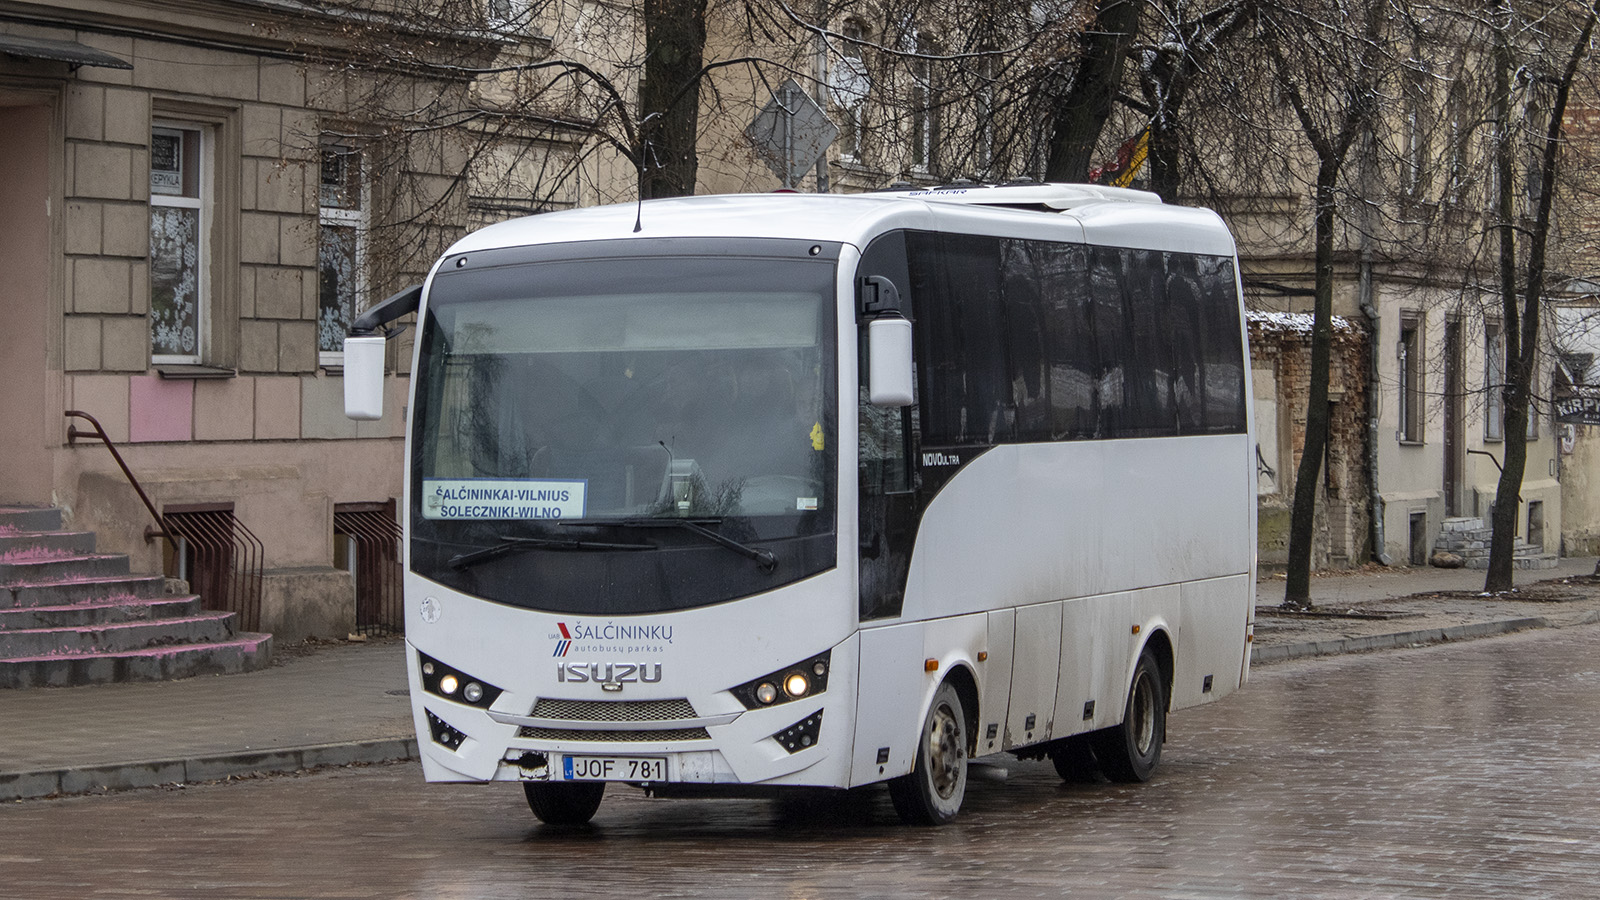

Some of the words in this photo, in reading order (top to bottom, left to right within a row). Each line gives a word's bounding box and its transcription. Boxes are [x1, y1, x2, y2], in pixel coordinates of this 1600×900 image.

[435, 485, 569, 502] ŠALČININKAI-VILNIUS
[440, 505, 562, 519] SOLECZNIKI-WILNO
[574, 620, 673, 645] ŠALČININKŲ
[574, 644, 624, 654] autobusų
[628, 644, 664, 654] parkas
[557, 662, 662, 683] ISUZU
[576, 760, 615, 778] JOF
[628, 760, 661, 779] 781
